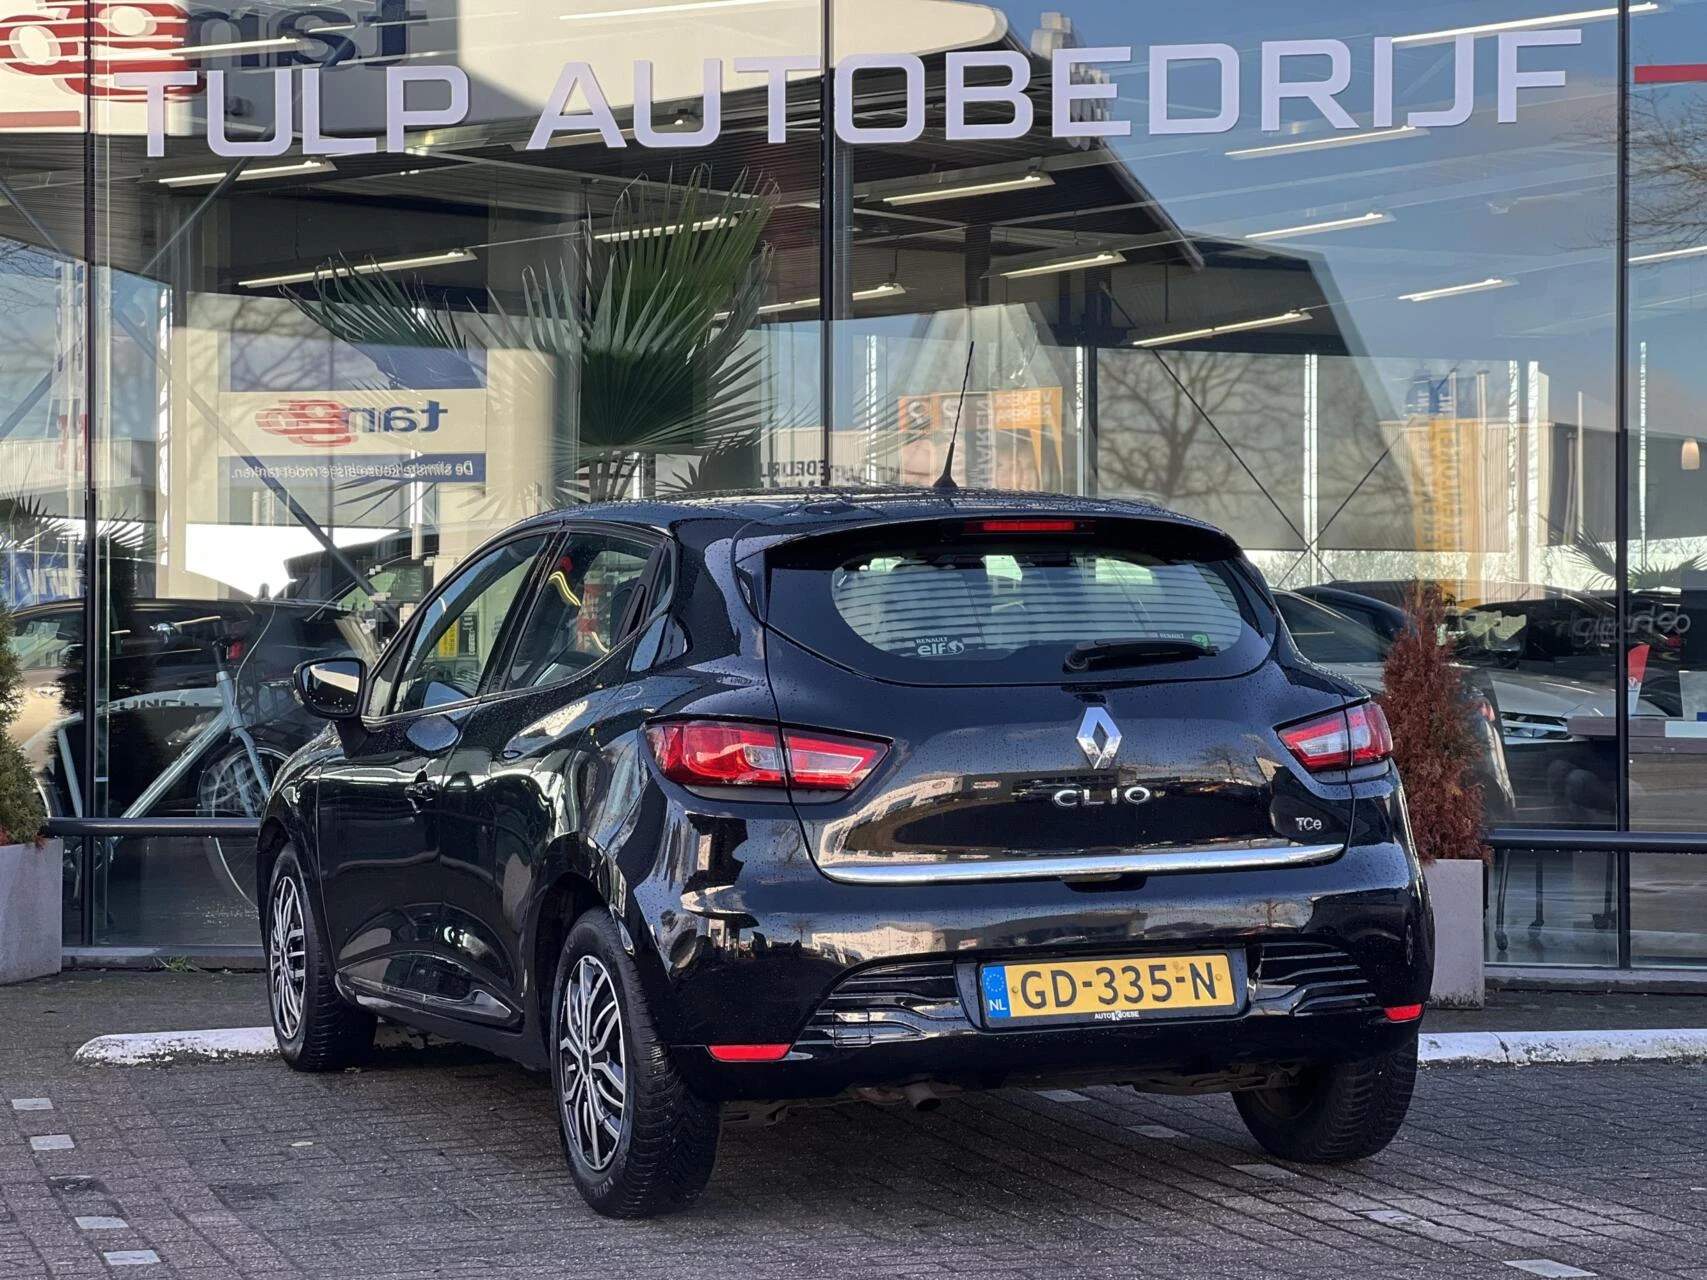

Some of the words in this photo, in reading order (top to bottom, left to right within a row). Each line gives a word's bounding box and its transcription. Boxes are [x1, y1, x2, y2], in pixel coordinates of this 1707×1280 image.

[114, 65, 470, 158] TULP
[526, 29, 1582, 151] AUTOBEDRIJF
[915, 636, 948, 644] RENAULT
[917, 642, 946, 655] elf
[1053, 786, 1151, 807] CLIO
[1295, 817, 1322, 831] TCe
[988, 998, 1007, 1012] NL
[1020, 962, 1217, 1010] GD-335-N
